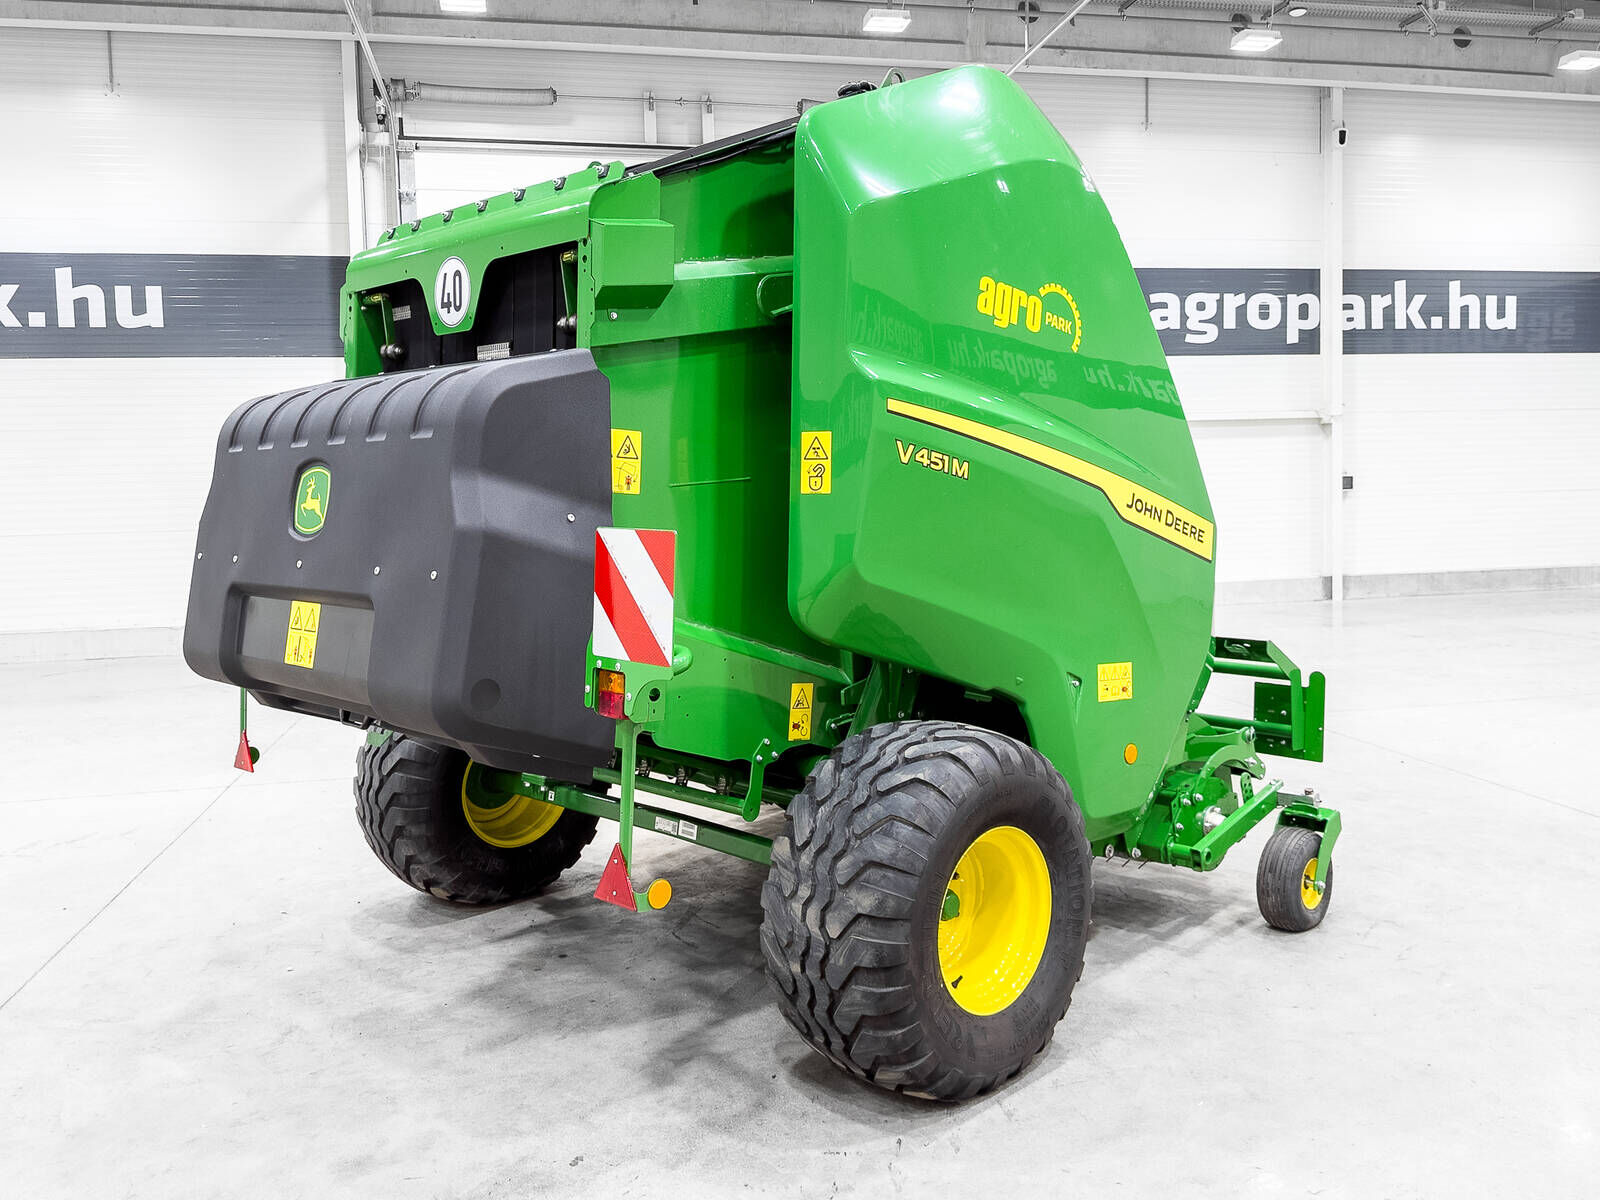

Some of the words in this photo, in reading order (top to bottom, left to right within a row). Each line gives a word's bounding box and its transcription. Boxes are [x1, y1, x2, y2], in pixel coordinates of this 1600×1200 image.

[440, 269, 463, 314] 40
[976, 275, 1043, 333] agro
[1045, 311, 1073, 335] PARK
[1149, 279, 1518, 344] agropark.hu
[1126, 492, 1162, 523] JOHN
[1164, 509, 1206, 544] DEERE
